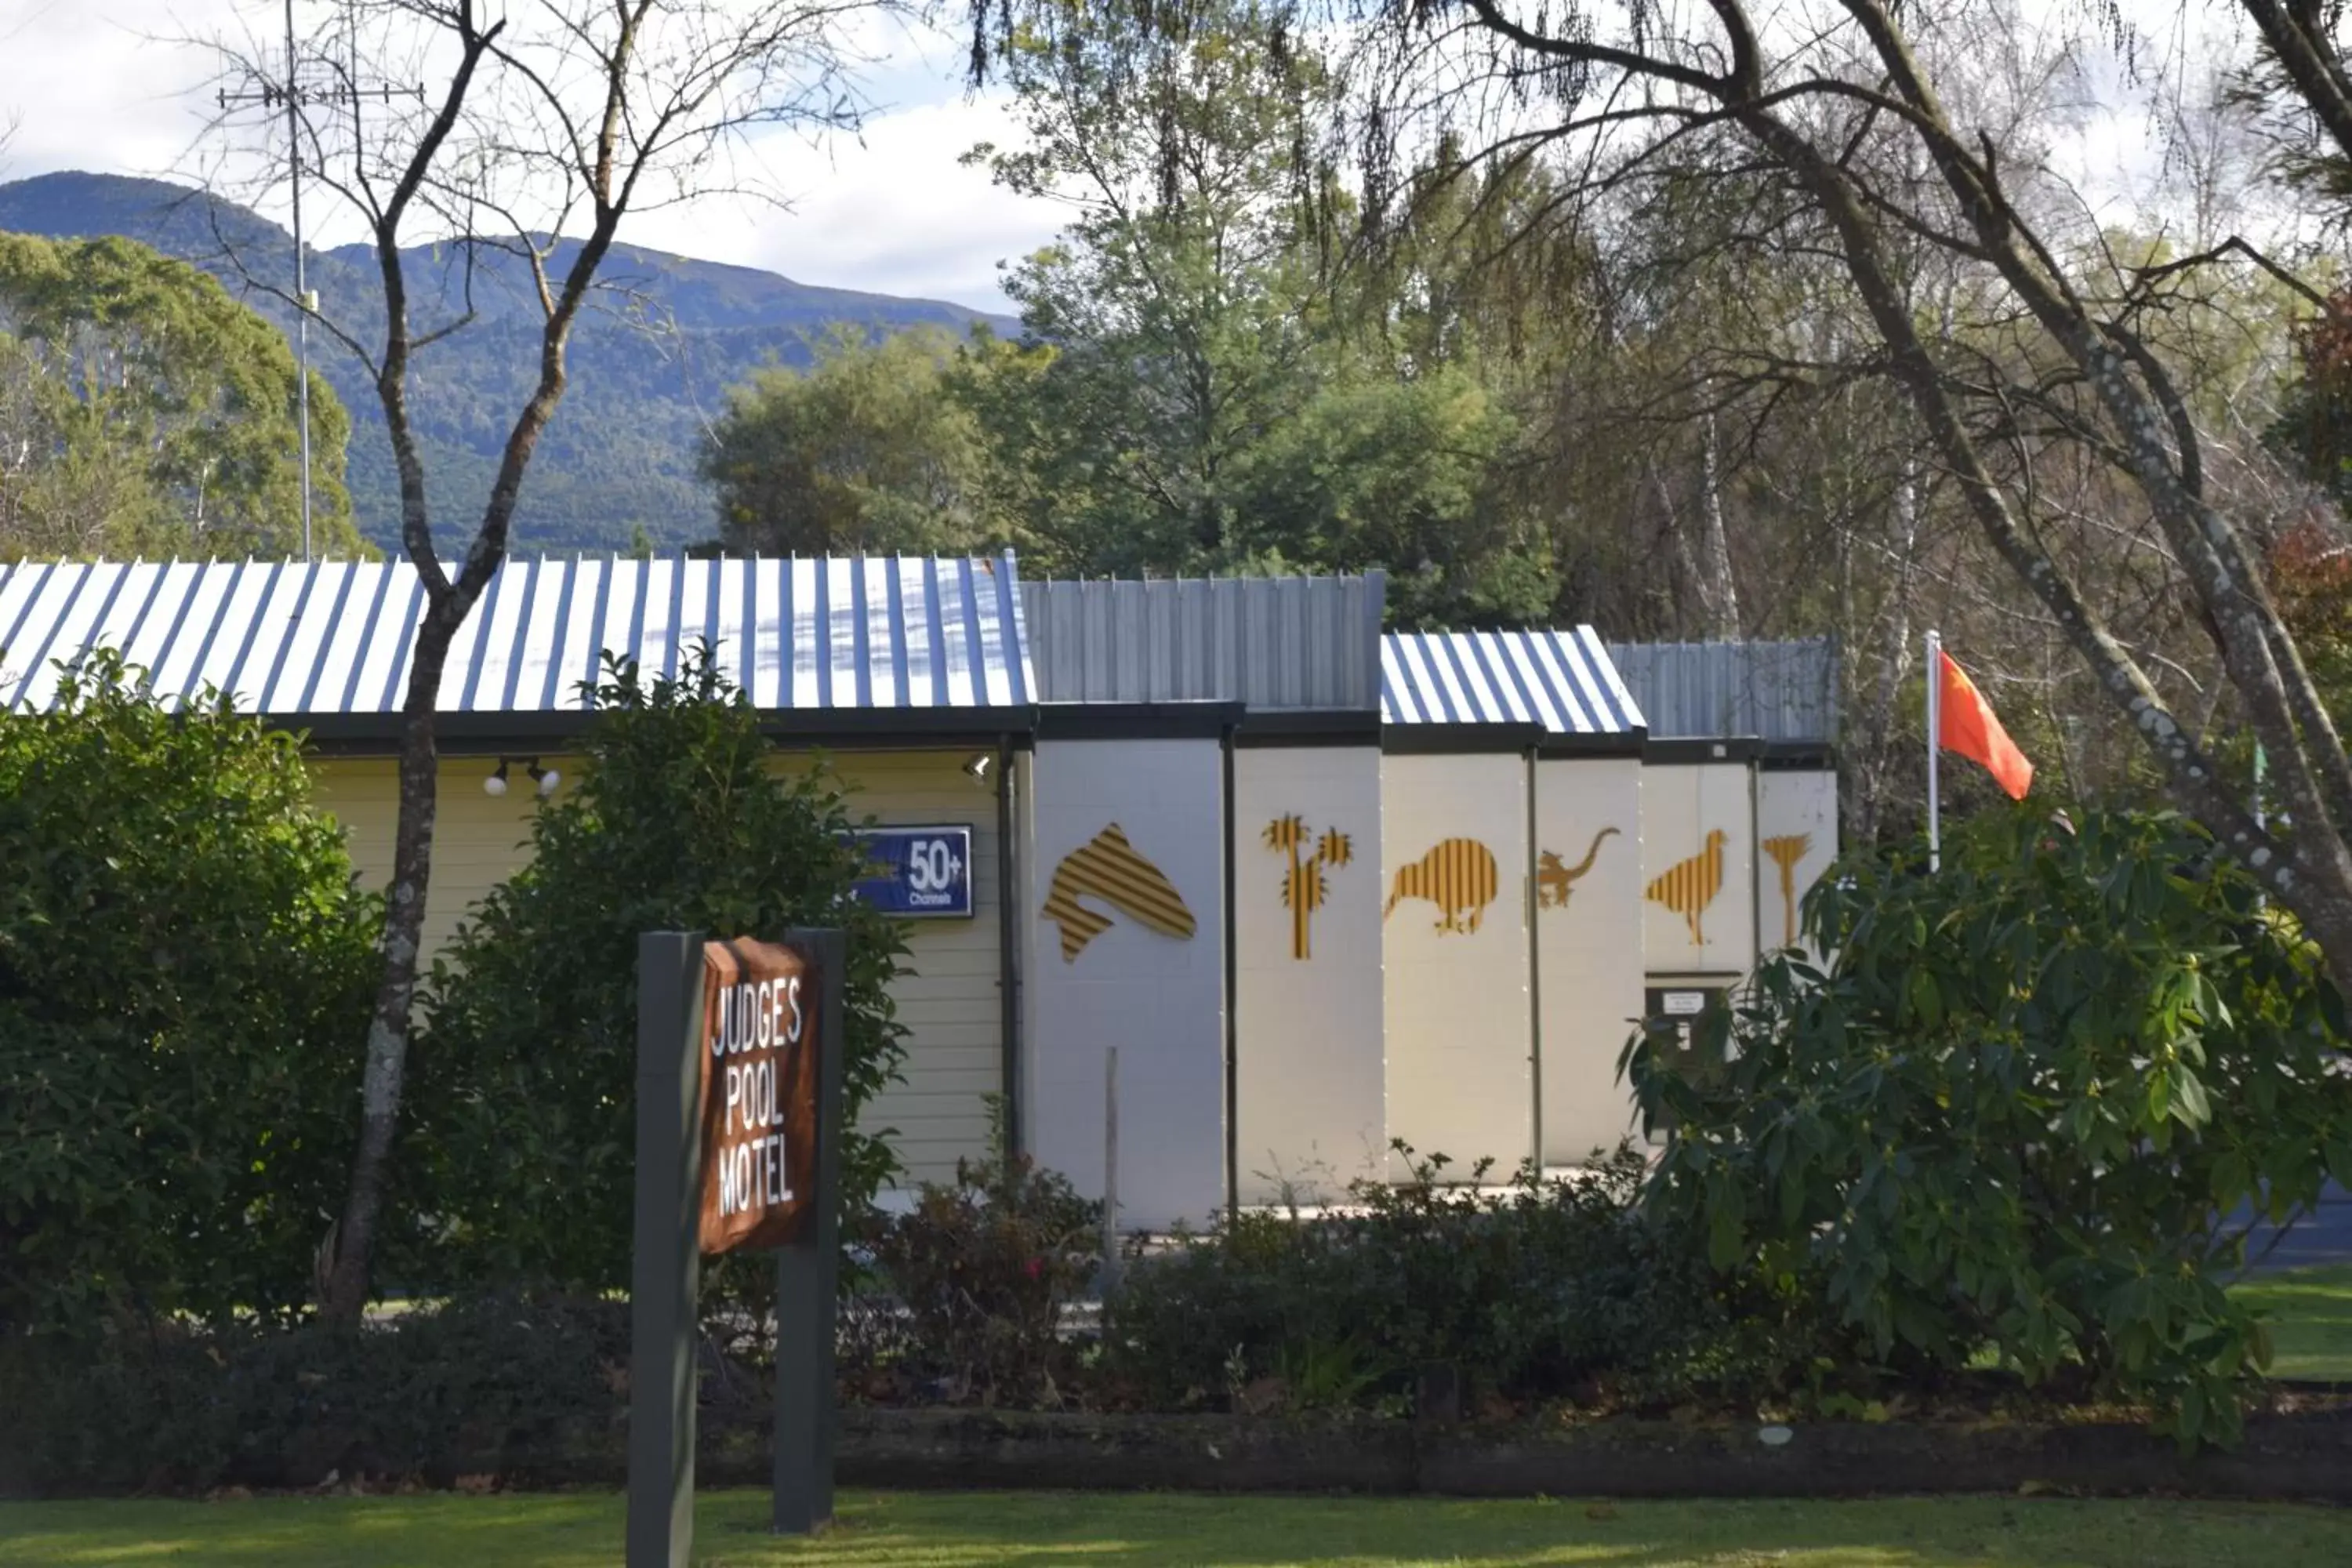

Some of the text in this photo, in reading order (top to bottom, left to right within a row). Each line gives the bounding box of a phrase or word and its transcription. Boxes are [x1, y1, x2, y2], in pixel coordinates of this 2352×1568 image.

[909, 839, 962, 890] 50+
[710, 976, 802, 1057] JUDGES
[726, 1058, 783, 1136] POOL
[718, 1133, 793, 1218] MOTEL
